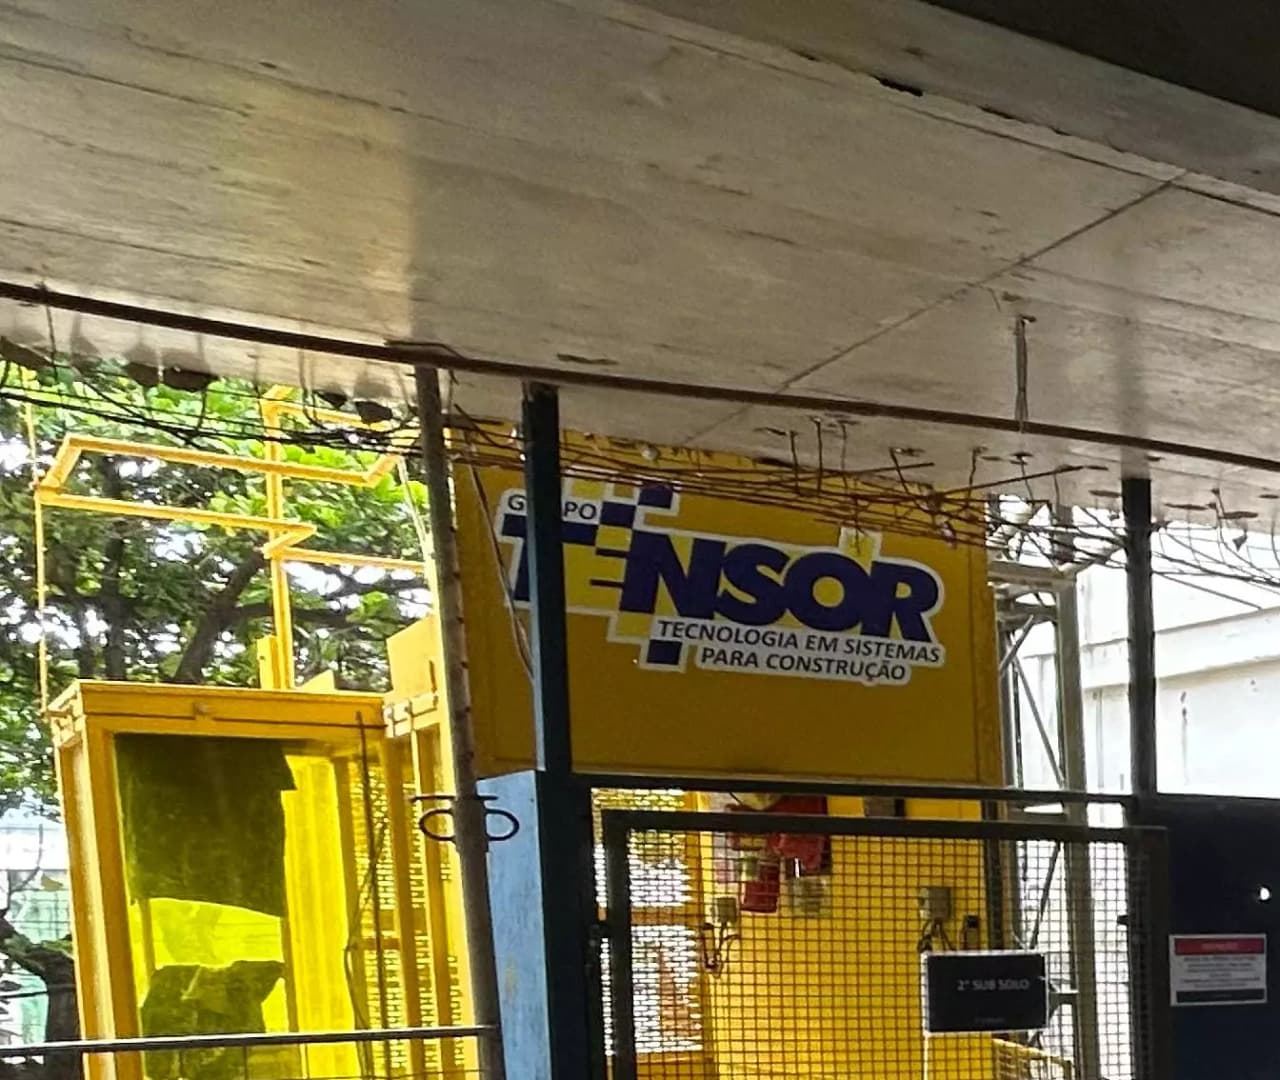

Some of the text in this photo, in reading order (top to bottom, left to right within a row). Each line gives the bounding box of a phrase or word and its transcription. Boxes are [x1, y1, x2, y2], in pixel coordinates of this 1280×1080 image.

[507, 494, 598, 520] GPO
[657, 619, 940, 663] TECNOLOGIA EM SISTEMAS
[701, 647, 906, 682] PARA CONSTRUÇÃO
